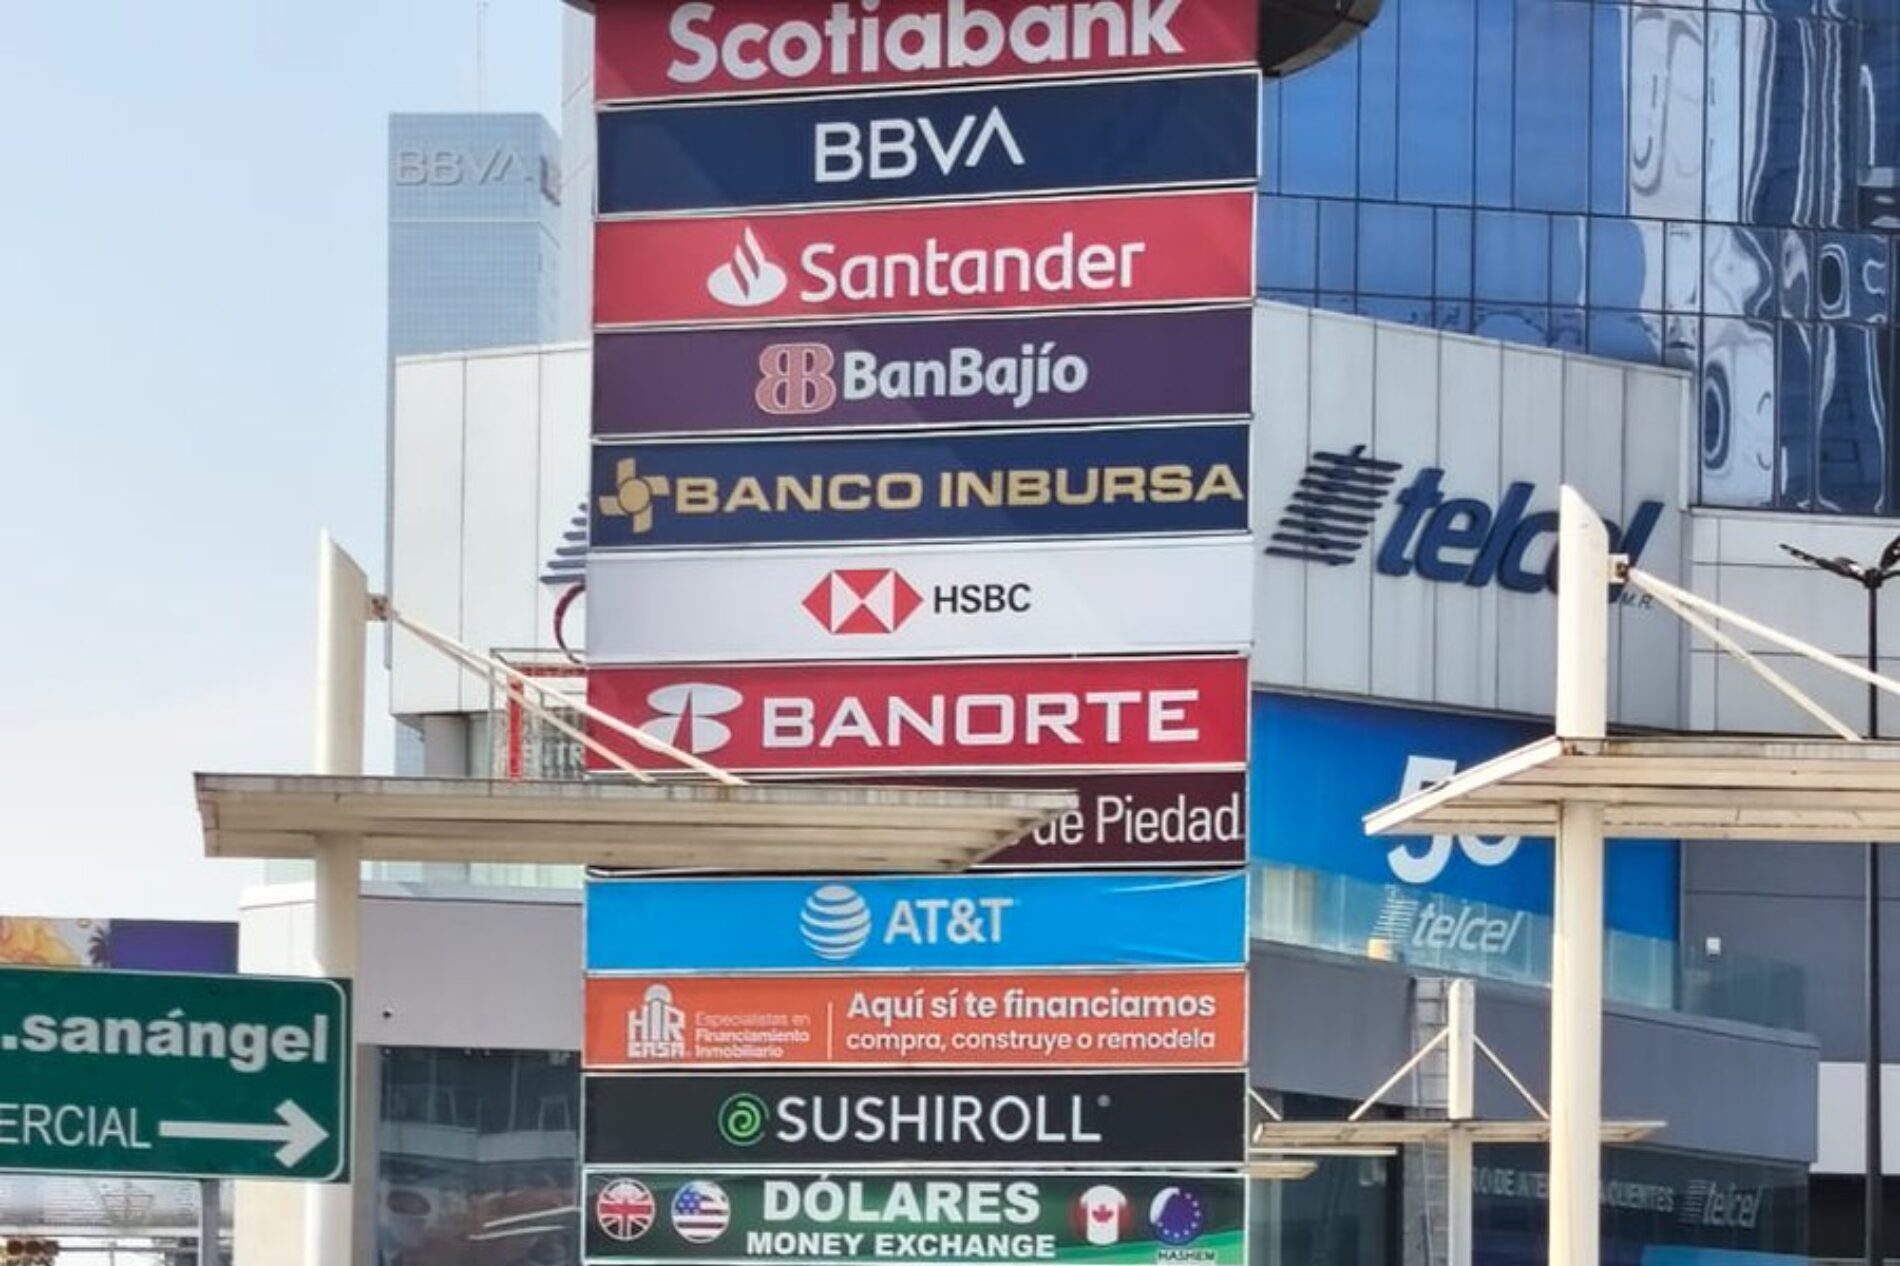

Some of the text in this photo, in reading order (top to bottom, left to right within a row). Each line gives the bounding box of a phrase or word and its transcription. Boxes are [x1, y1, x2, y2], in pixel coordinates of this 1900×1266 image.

[666, 0, 1186, 84] Scotiabank
[815, 106, 1025, 183] BBVA
[800, 232, 1146, 302] Santander
[843, 341, 1089, 408] BanBajío
[675, 464, 1244, 514] BANCO INBURSA
[1376, 467, 1664, 603] telcl
[934, 583, 1033, 614] HSBC
[762, 689, 1200, 750] BANORTE
[1097, 793, 1240, 844] Piedad
[884, 899, 1013, 944] AT&T
[1411, 903, 1522, 954] telcel
[696, 1012, 811, 1027] Especialistas en
[847, 989, 1216, 1026] Aquí sí te financiamos
[696, 1028, 810, 1043] Financiamiento
[696, 1044, 784, 1058] Inmobiliario
[846, 1028, 1215, 1055] compra, construye o remodela
[0, 1103, 152, 1149] ERCIAL
[776, 1094, 1102, 1143] SUSHIROLL
[763, 1174, 1040, 1223] DÓLARES
[746, 1232, 1055, 1259] MONEY EXCHANGE
